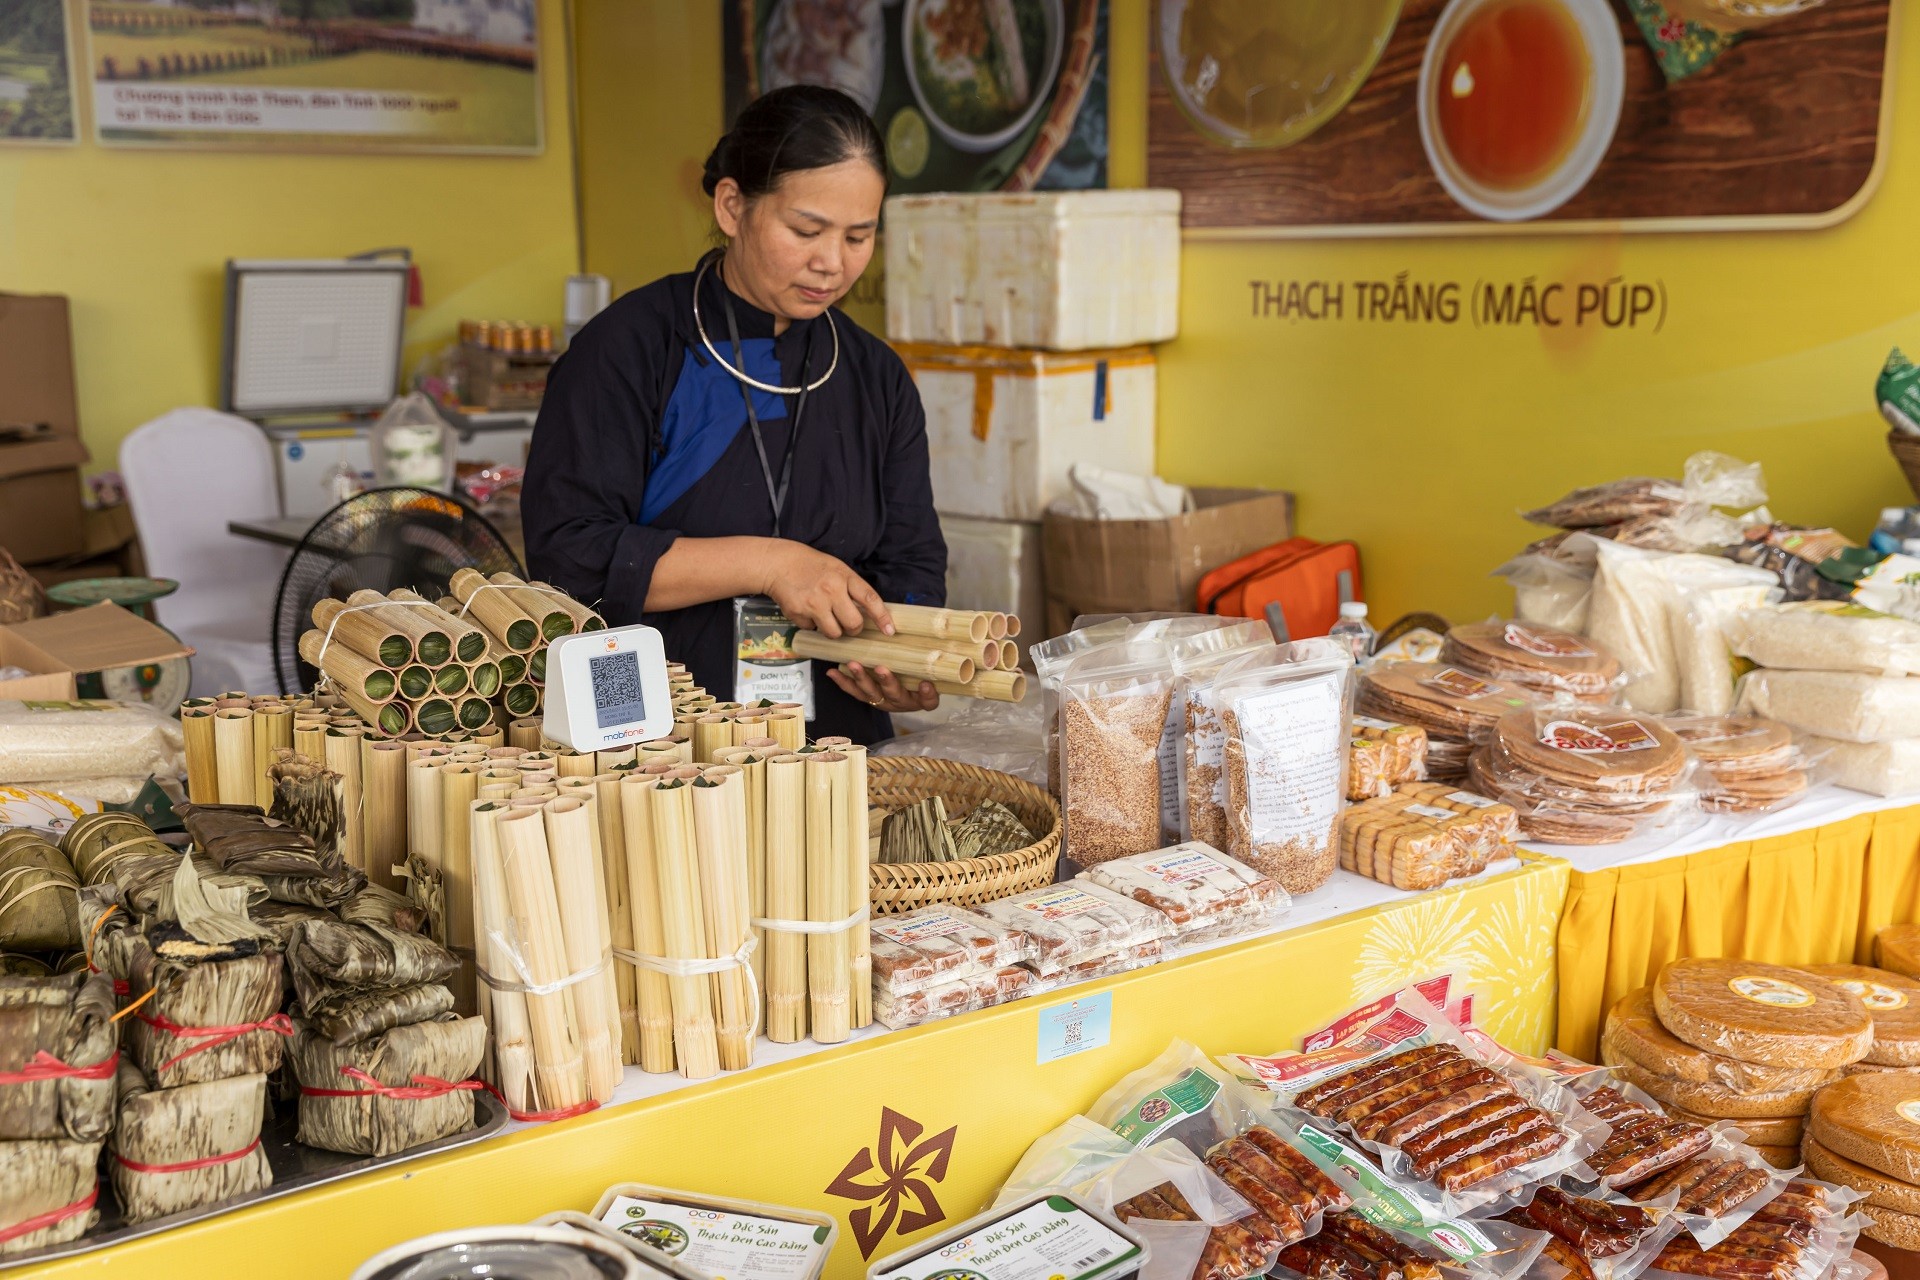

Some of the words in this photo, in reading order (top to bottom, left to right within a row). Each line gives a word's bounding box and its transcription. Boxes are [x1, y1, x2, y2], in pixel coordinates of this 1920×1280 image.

[1249, 279, 1344, 325] THẠCH
[1353, 270, 1461, 324] TRẮNG
[1576, 275, 1668, 333] PÚP)
[603, 728, 644, 741] mobifone
[688, 1209, 726, 1221] OCOP
[697, 1228, 729, 1241] Thạch
[730, 1234, 752, 1245] Đen
[755, 1238, 777, 1248] Cao
[940, 1238, 973, 1257] OCOP
[969, 1248, 1002, 1266] Thạch
[1002, 1240, 1024, 1253] Đen
[1022, 1231, 1041, 1243] Cao
